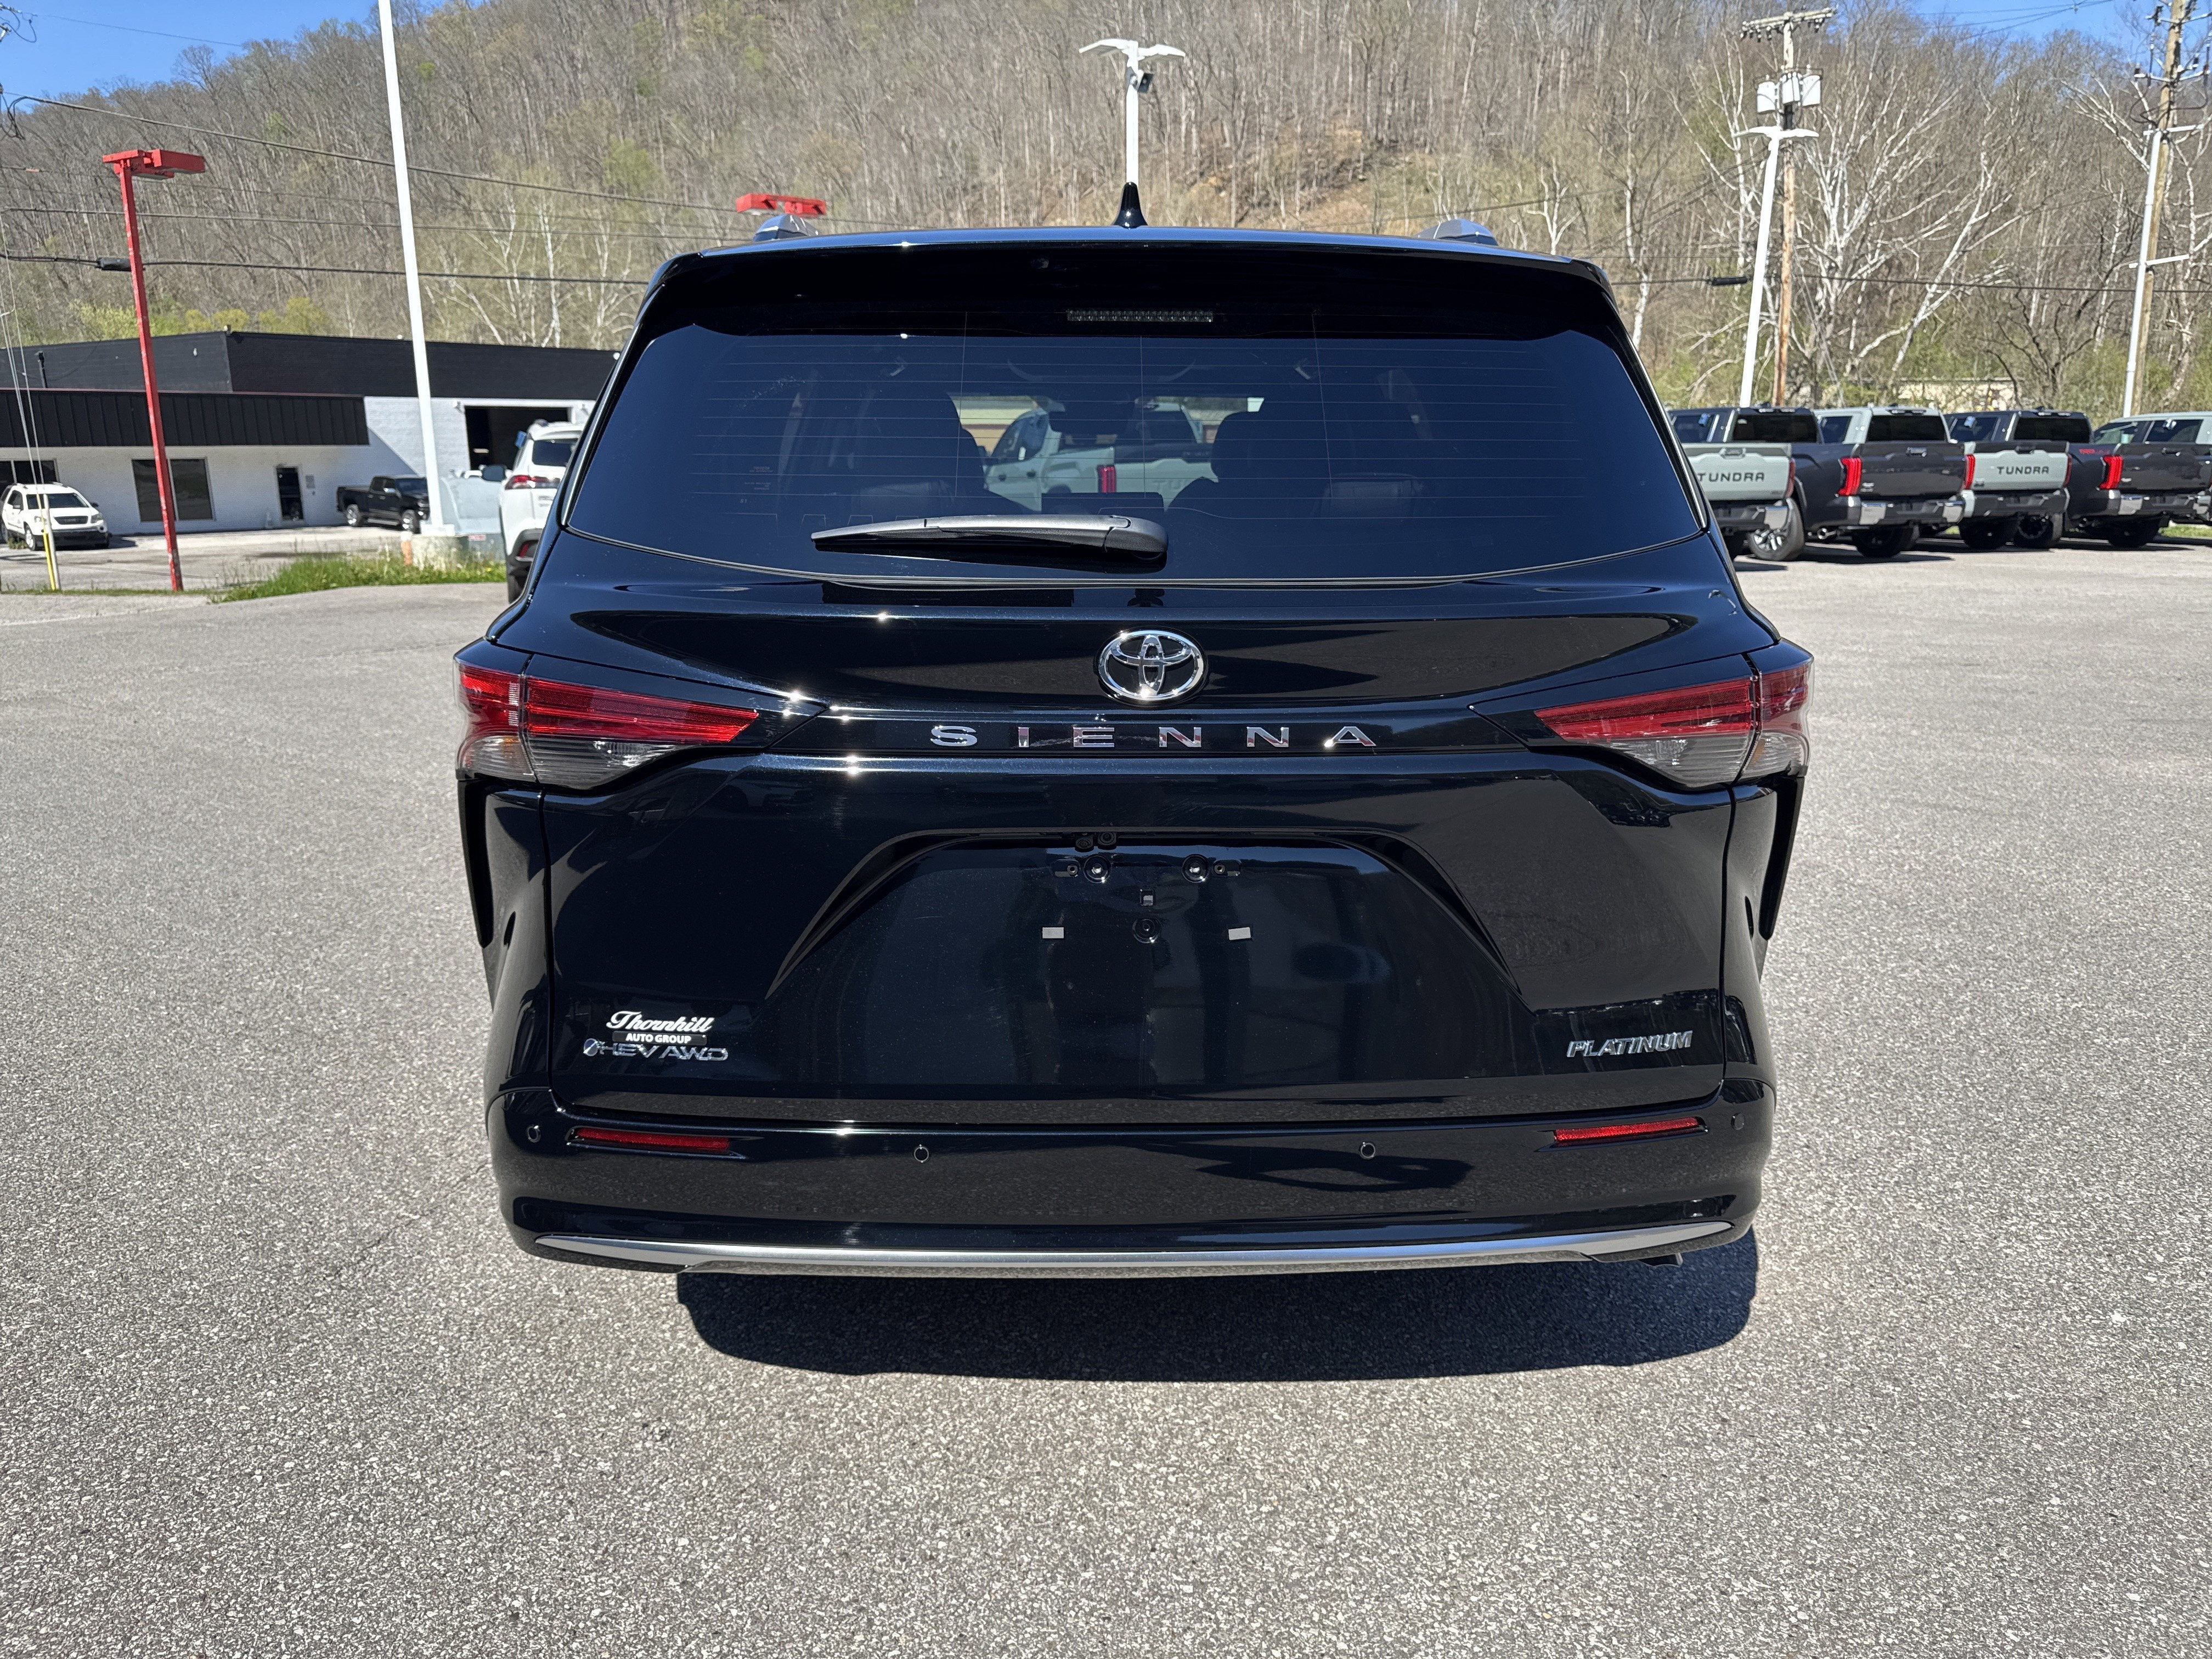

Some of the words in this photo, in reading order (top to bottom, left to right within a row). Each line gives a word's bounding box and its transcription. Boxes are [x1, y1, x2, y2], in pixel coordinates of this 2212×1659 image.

[1697, 472, 1765, 482] TUNDRA
[1997, 466, 2050, 475] TUNDRA
[930, 725, 1377, 748] SIENNA
[606, 1010, 715, 1033] Thornhill
[625, 1033, 653, 1043] AUTO
[655, 1034, 692, 1044] GROUP
[1566, 1030, 1693, 1057] PLATINUM
[659, 1045, 729, 1061] AWD
